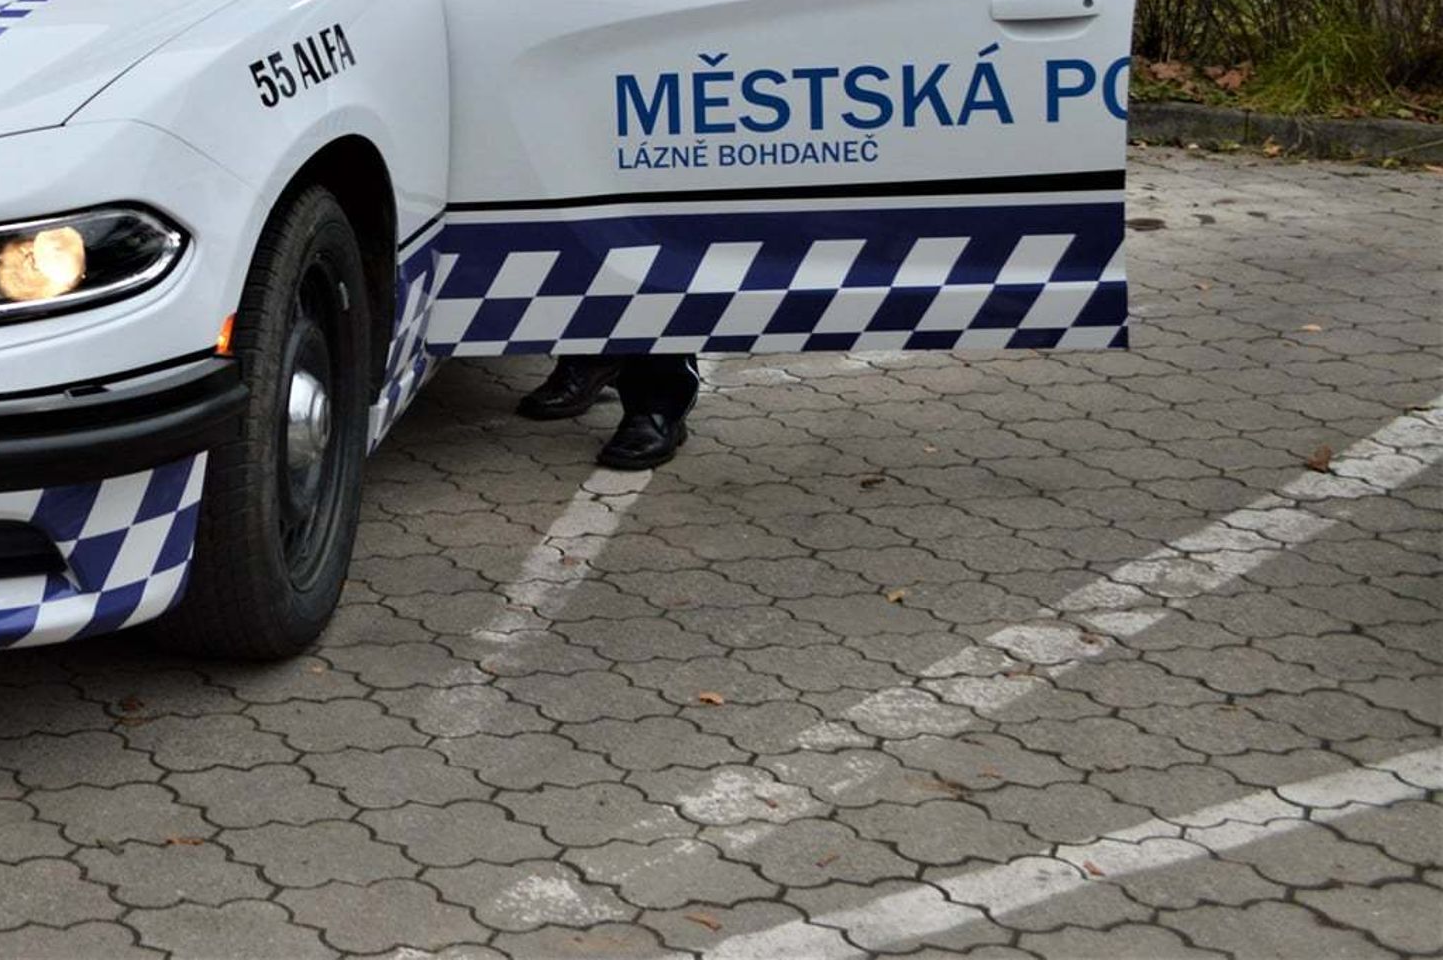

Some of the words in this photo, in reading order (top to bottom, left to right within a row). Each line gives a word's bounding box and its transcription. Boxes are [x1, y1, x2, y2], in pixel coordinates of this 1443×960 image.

[248, 50, 297, 108] 55
[292, 23, 356, 90] ALFA
[615, 43, 1014, 137] MĚSTSKÁ
[617, 139, 709, 170] LÁZNĚ
[718, 133, 879, 168] BOHDANEČ
